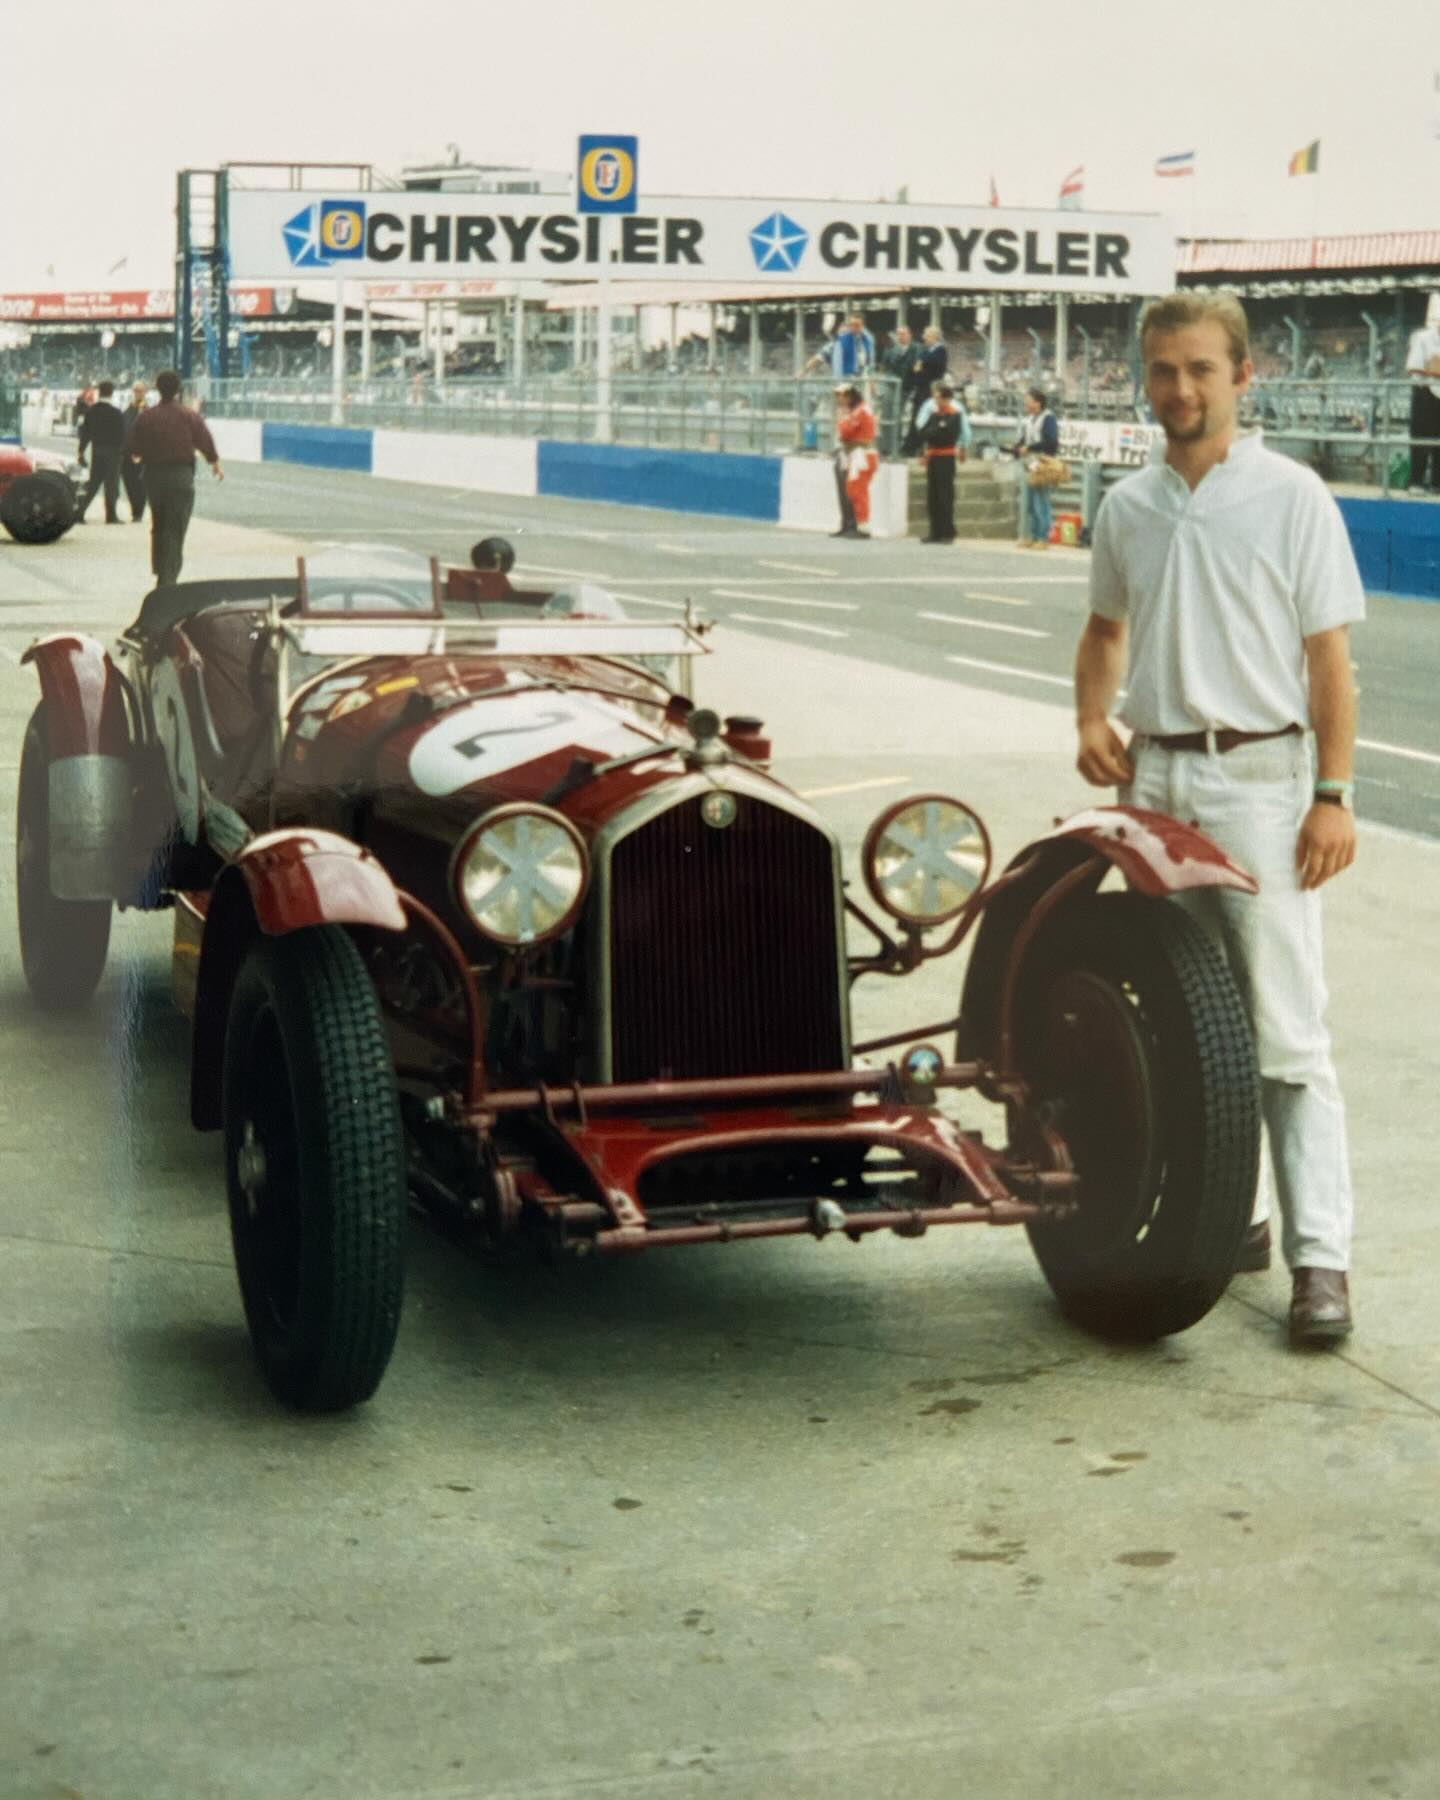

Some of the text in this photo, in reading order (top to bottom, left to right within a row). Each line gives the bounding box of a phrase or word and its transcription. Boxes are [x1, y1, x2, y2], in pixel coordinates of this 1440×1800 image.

[365, 213, 704, 264] CHRYSLER
[819, 221, 1131, 278] CHRYSLER
[454, 711, 575, 760] 2
